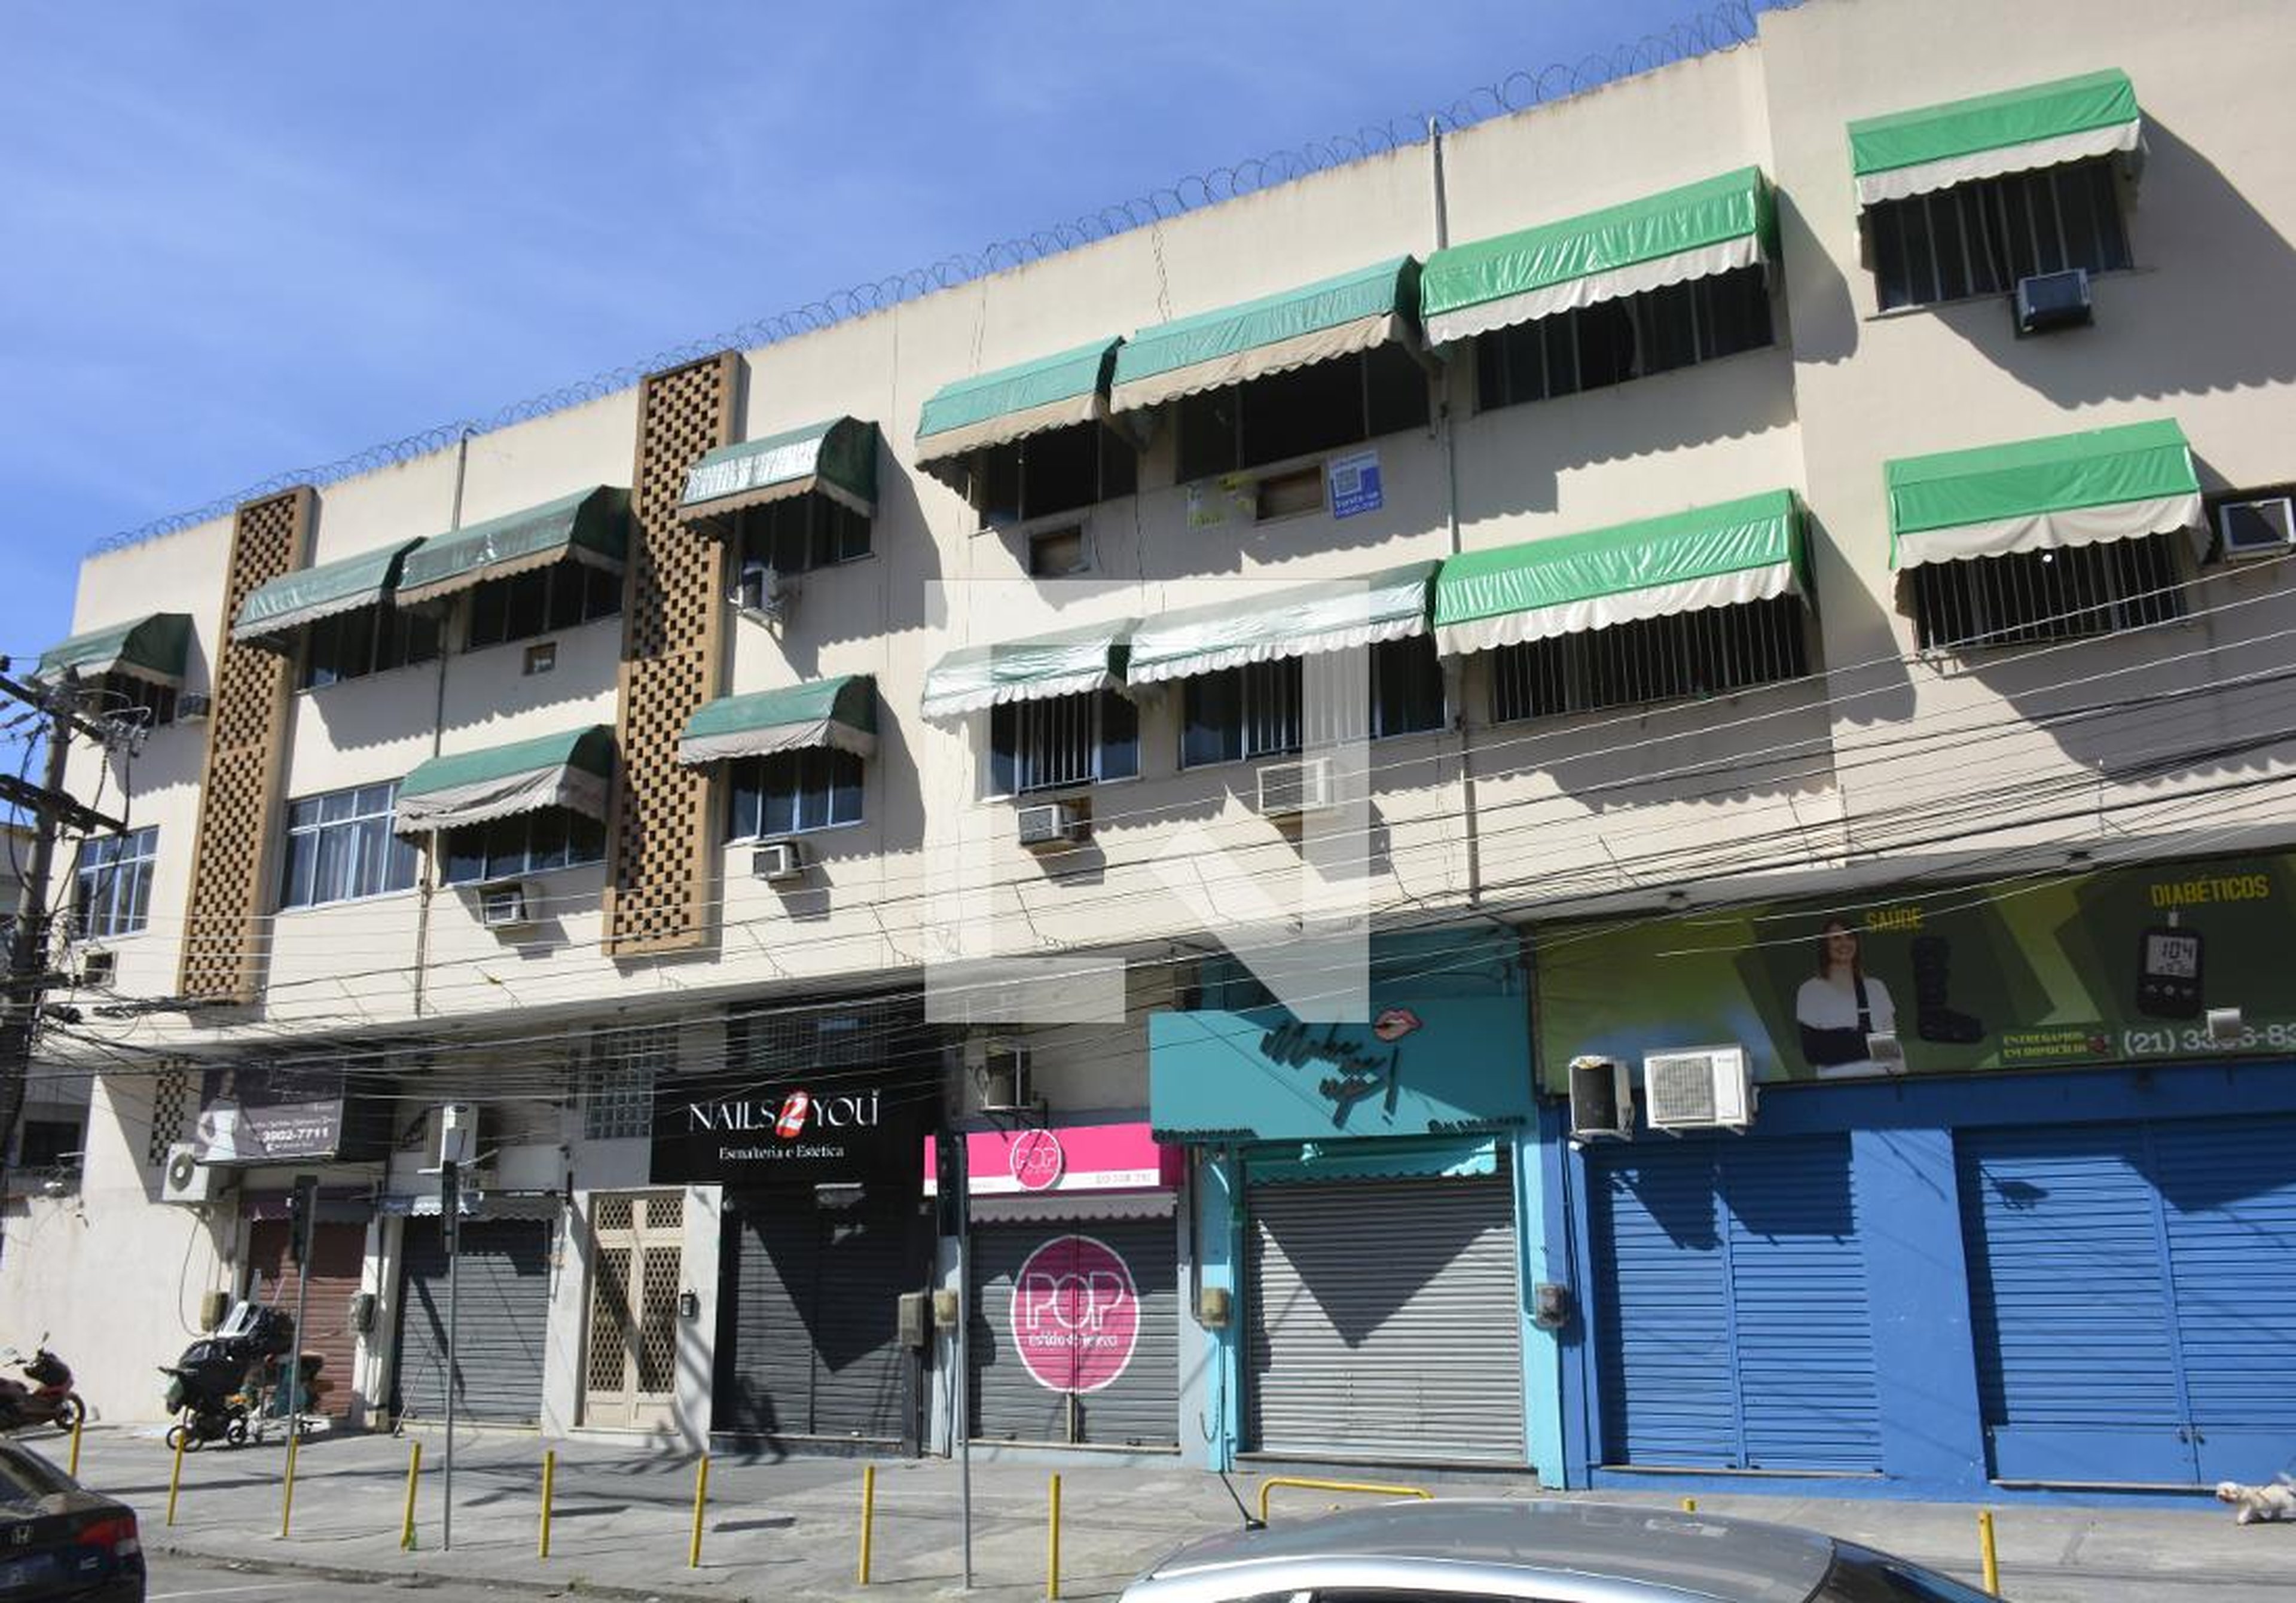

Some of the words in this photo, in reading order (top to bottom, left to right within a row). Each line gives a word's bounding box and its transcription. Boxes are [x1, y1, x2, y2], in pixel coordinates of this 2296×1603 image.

[2151, 874, 2270, 908] DIABÉTICOS
[2124, 1028, 2176, 1056] (21)
[689, 1101, 776, 1131] NAILS
[811, 1095, 878, 1127] YOU
[719, 1146, 783, 1159] Esmalteria
[1016, 1147, 1057, 1170] POP
[1026, 1271, 1125, 1330] POP
